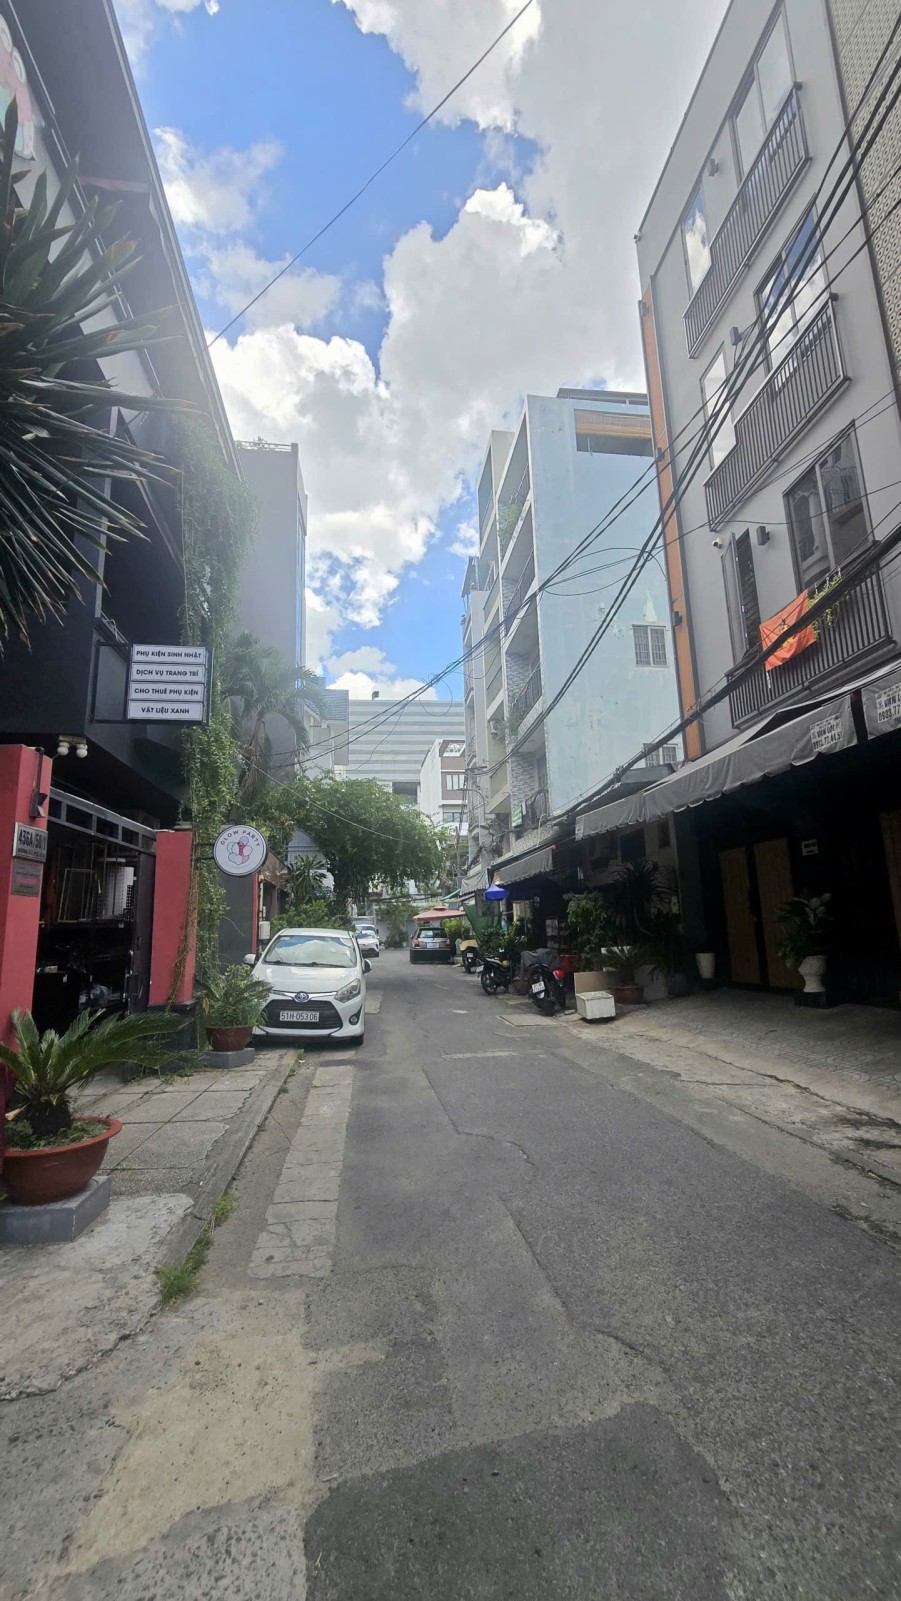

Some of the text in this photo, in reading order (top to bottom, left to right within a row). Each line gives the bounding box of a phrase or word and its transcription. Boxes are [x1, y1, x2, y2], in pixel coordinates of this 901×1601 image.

[136, 650, 149, 658] PHỤ
[151, 650, 166, 658] KIỆN
[141, 706, 154, 714] VẬT
[220, 830, 261, 847] GLOW PARTY
